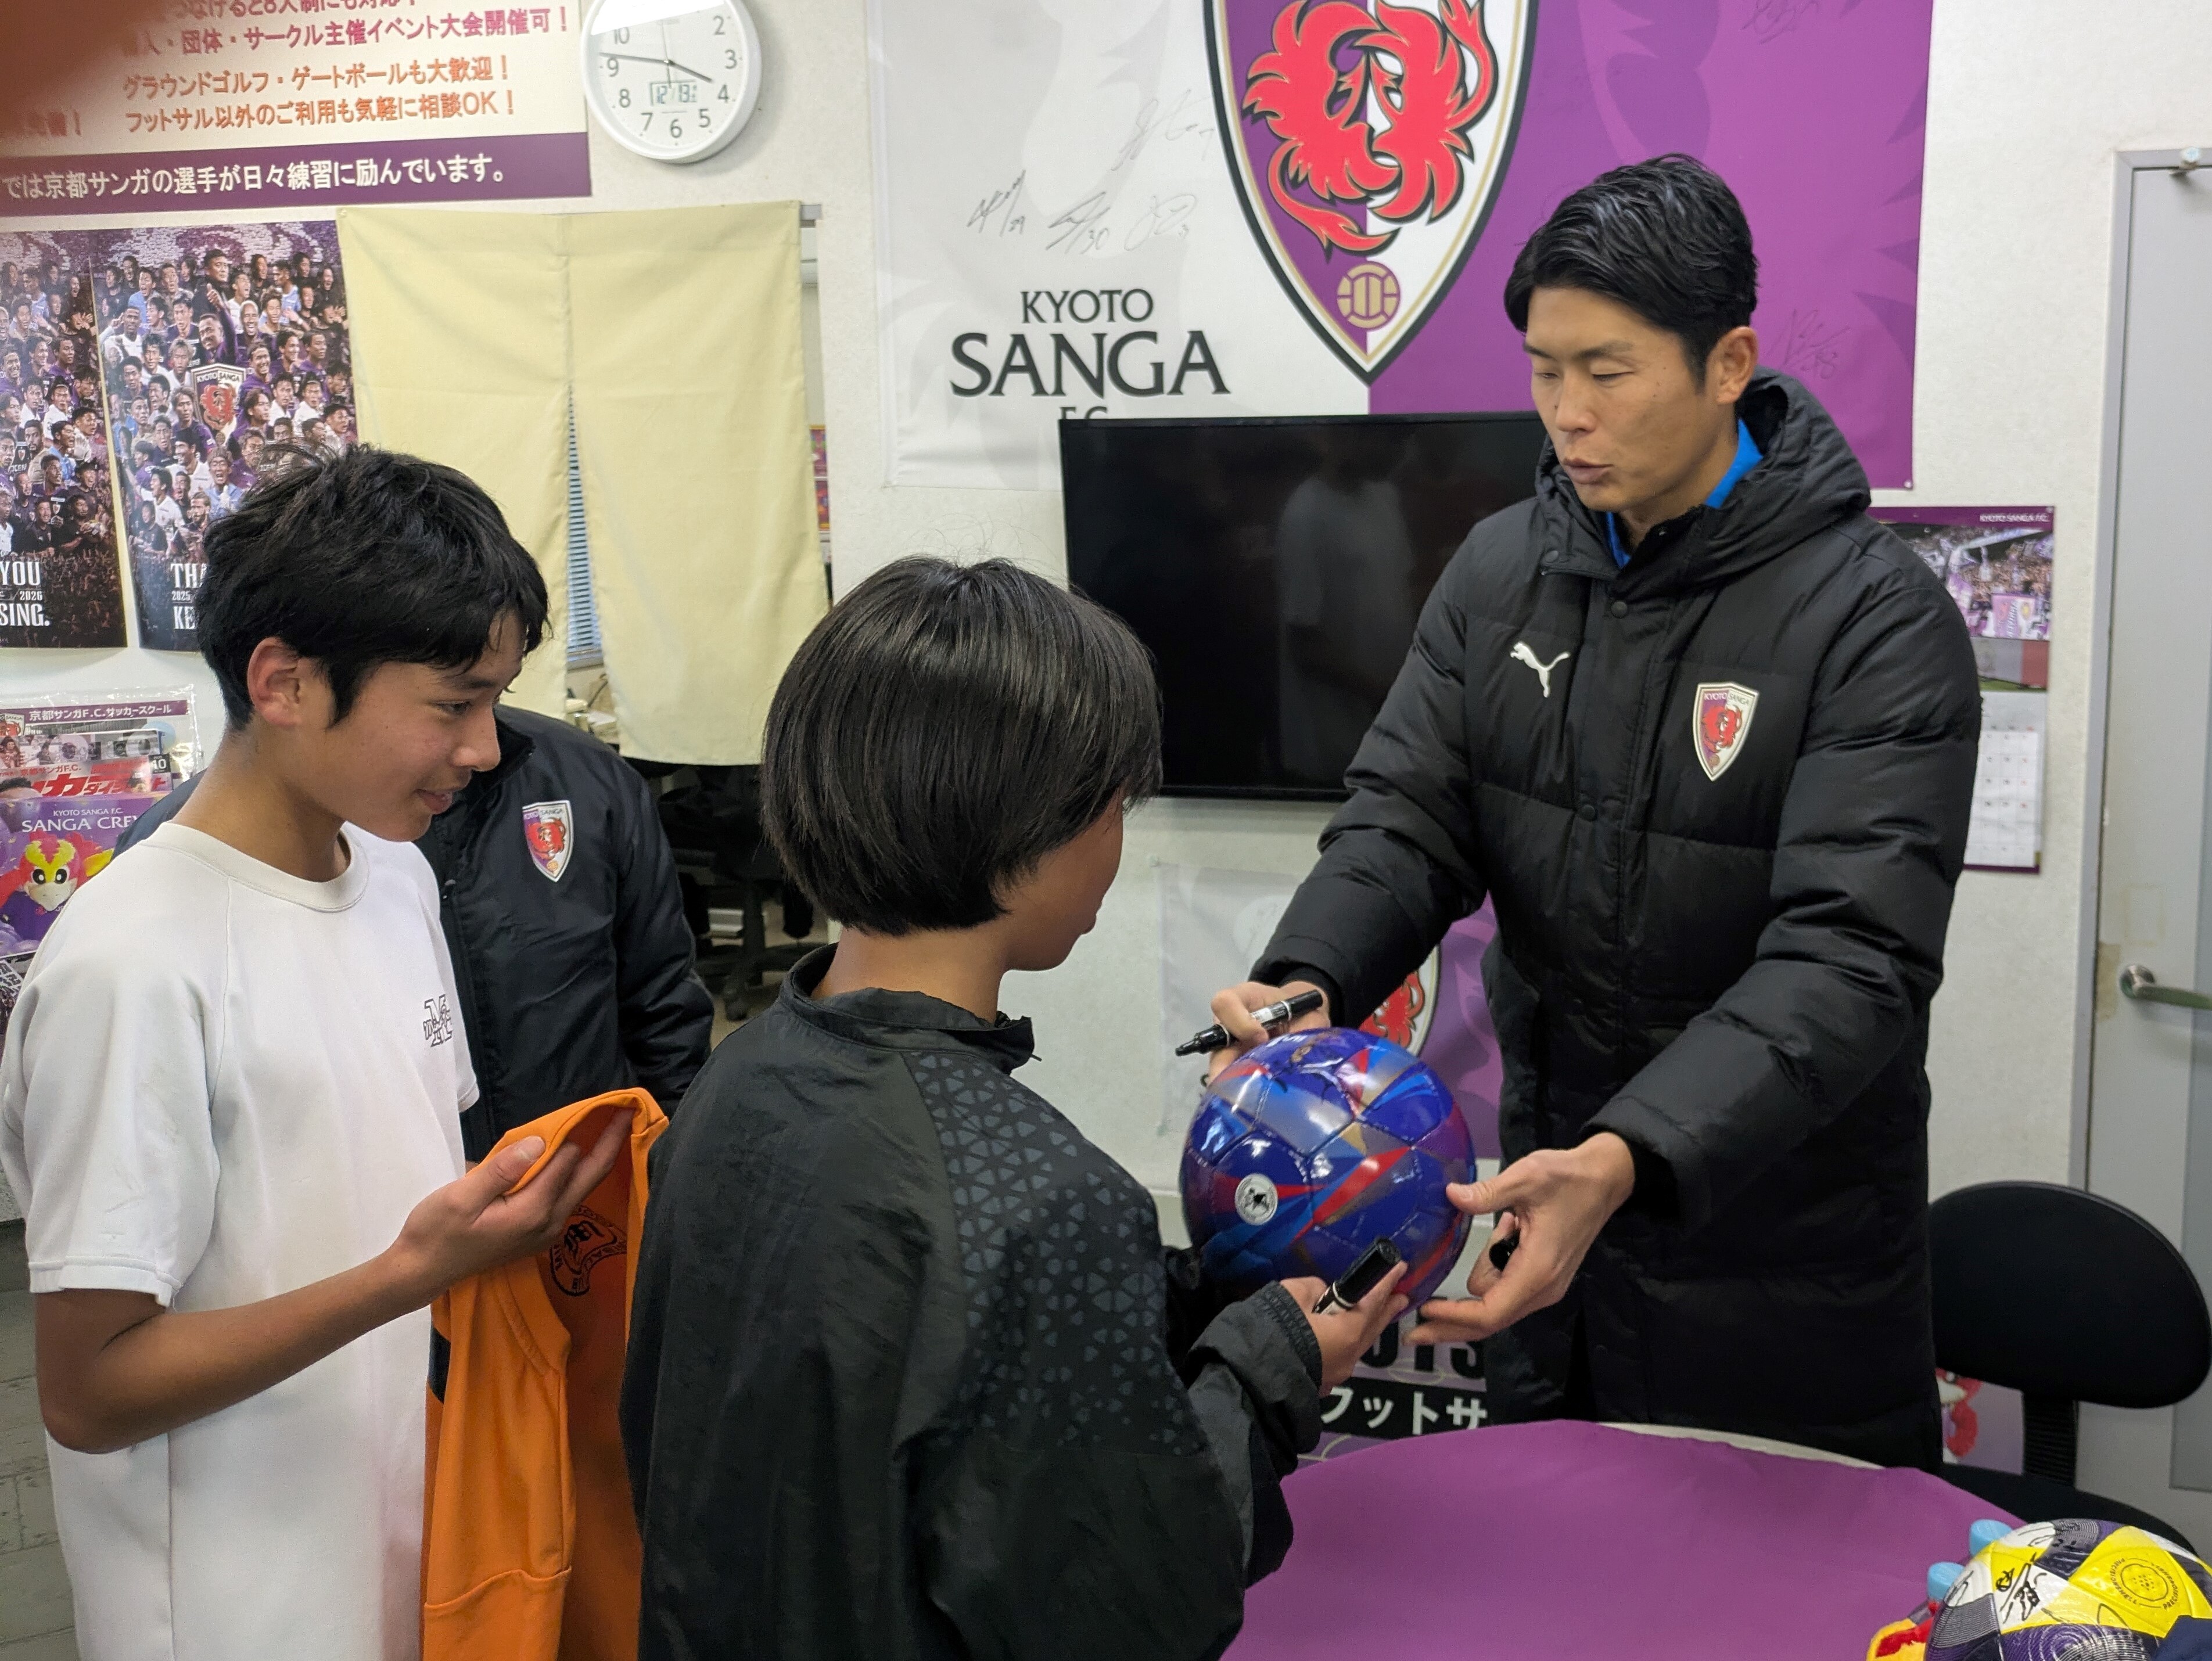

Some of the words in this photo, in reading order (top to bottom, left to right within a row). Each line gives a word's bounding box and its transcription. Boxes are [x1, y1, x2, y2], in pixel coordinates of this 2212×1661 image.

[121, 7, 567, 56] 人・団体・サークル主催イベント大会開催可！
[713, 15, 726, 35] 2
[613, 27, 630, 44] 10
[607, 57, 619, 77] 9
[724, 49, 737, 69] 3
[122, 55, 509, 100] グラウンドゴルフ・ゲートボールも大歓迎！
[619, 89, 631, 108] 8
[717, 84, 730, 103] 4
[126, 90, 514, 133] フットサル以外のご利用も気軽に相談OK！
[699, 109, 710, 128] 5
[641, 112, 653, 131] 7
[670, 119, 682, 138] 6
[1021, 288, 1154, 323] KYOTO
[950, 330, 1231, 400] SANGA
[19, 591, 43, 601] 2026
[172, 591, 191, 601] 2025
[29, 705, 172, 722] 京都サンガF.C.サッカースクール
[21, 818, 91, 833] SANGA
[1320, 1386, 1488, 1436] フットサ
